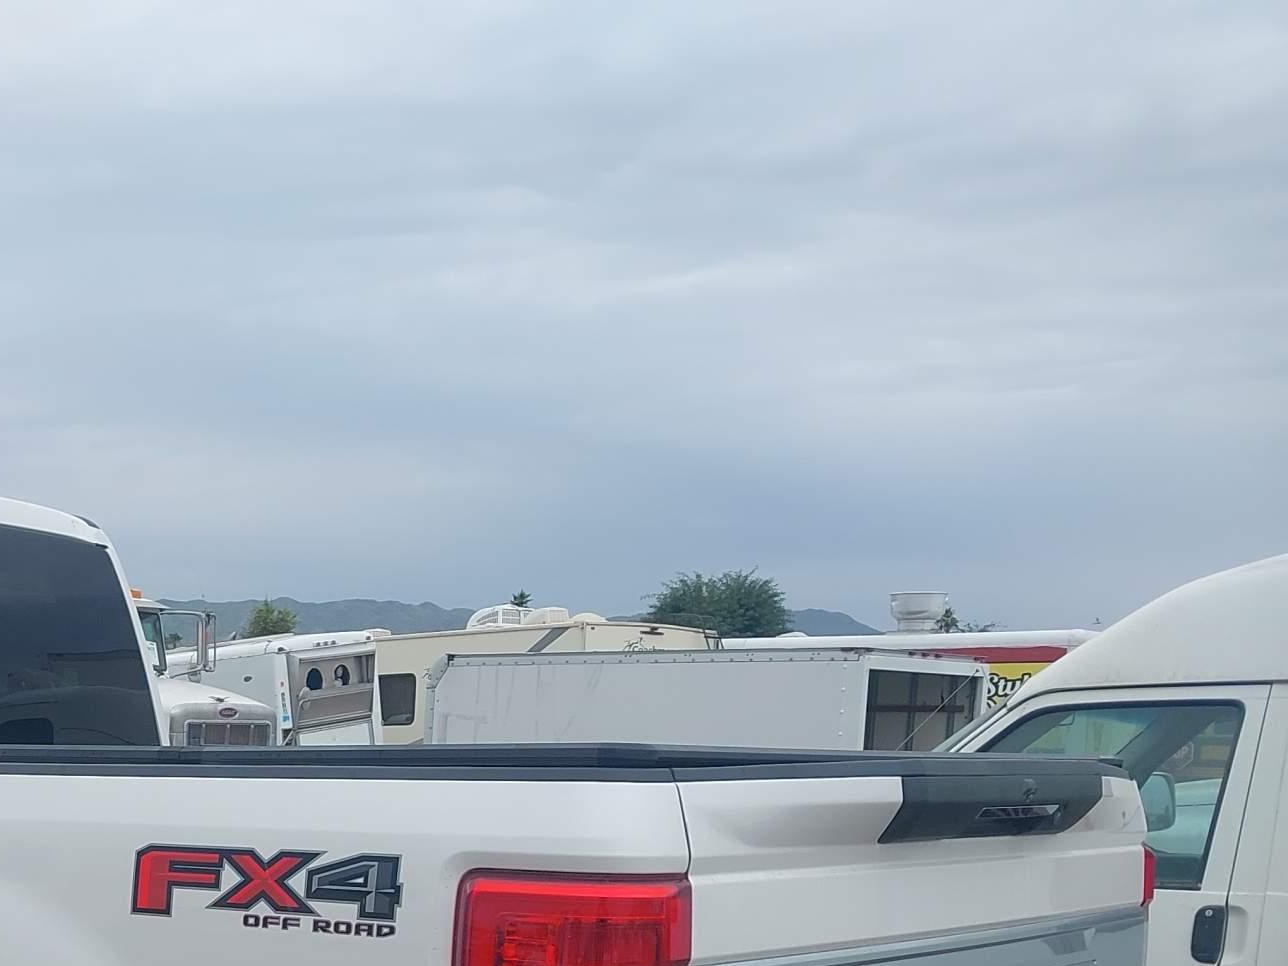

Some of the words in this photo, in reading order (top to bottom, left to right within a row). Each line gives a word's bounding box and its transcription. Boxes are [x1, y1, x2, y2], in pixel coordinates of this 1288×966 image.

[130, 841, 404, 923] FX4
[243, 913, 301, 931] OFF
[312, 917, 397, 939] ROAD
